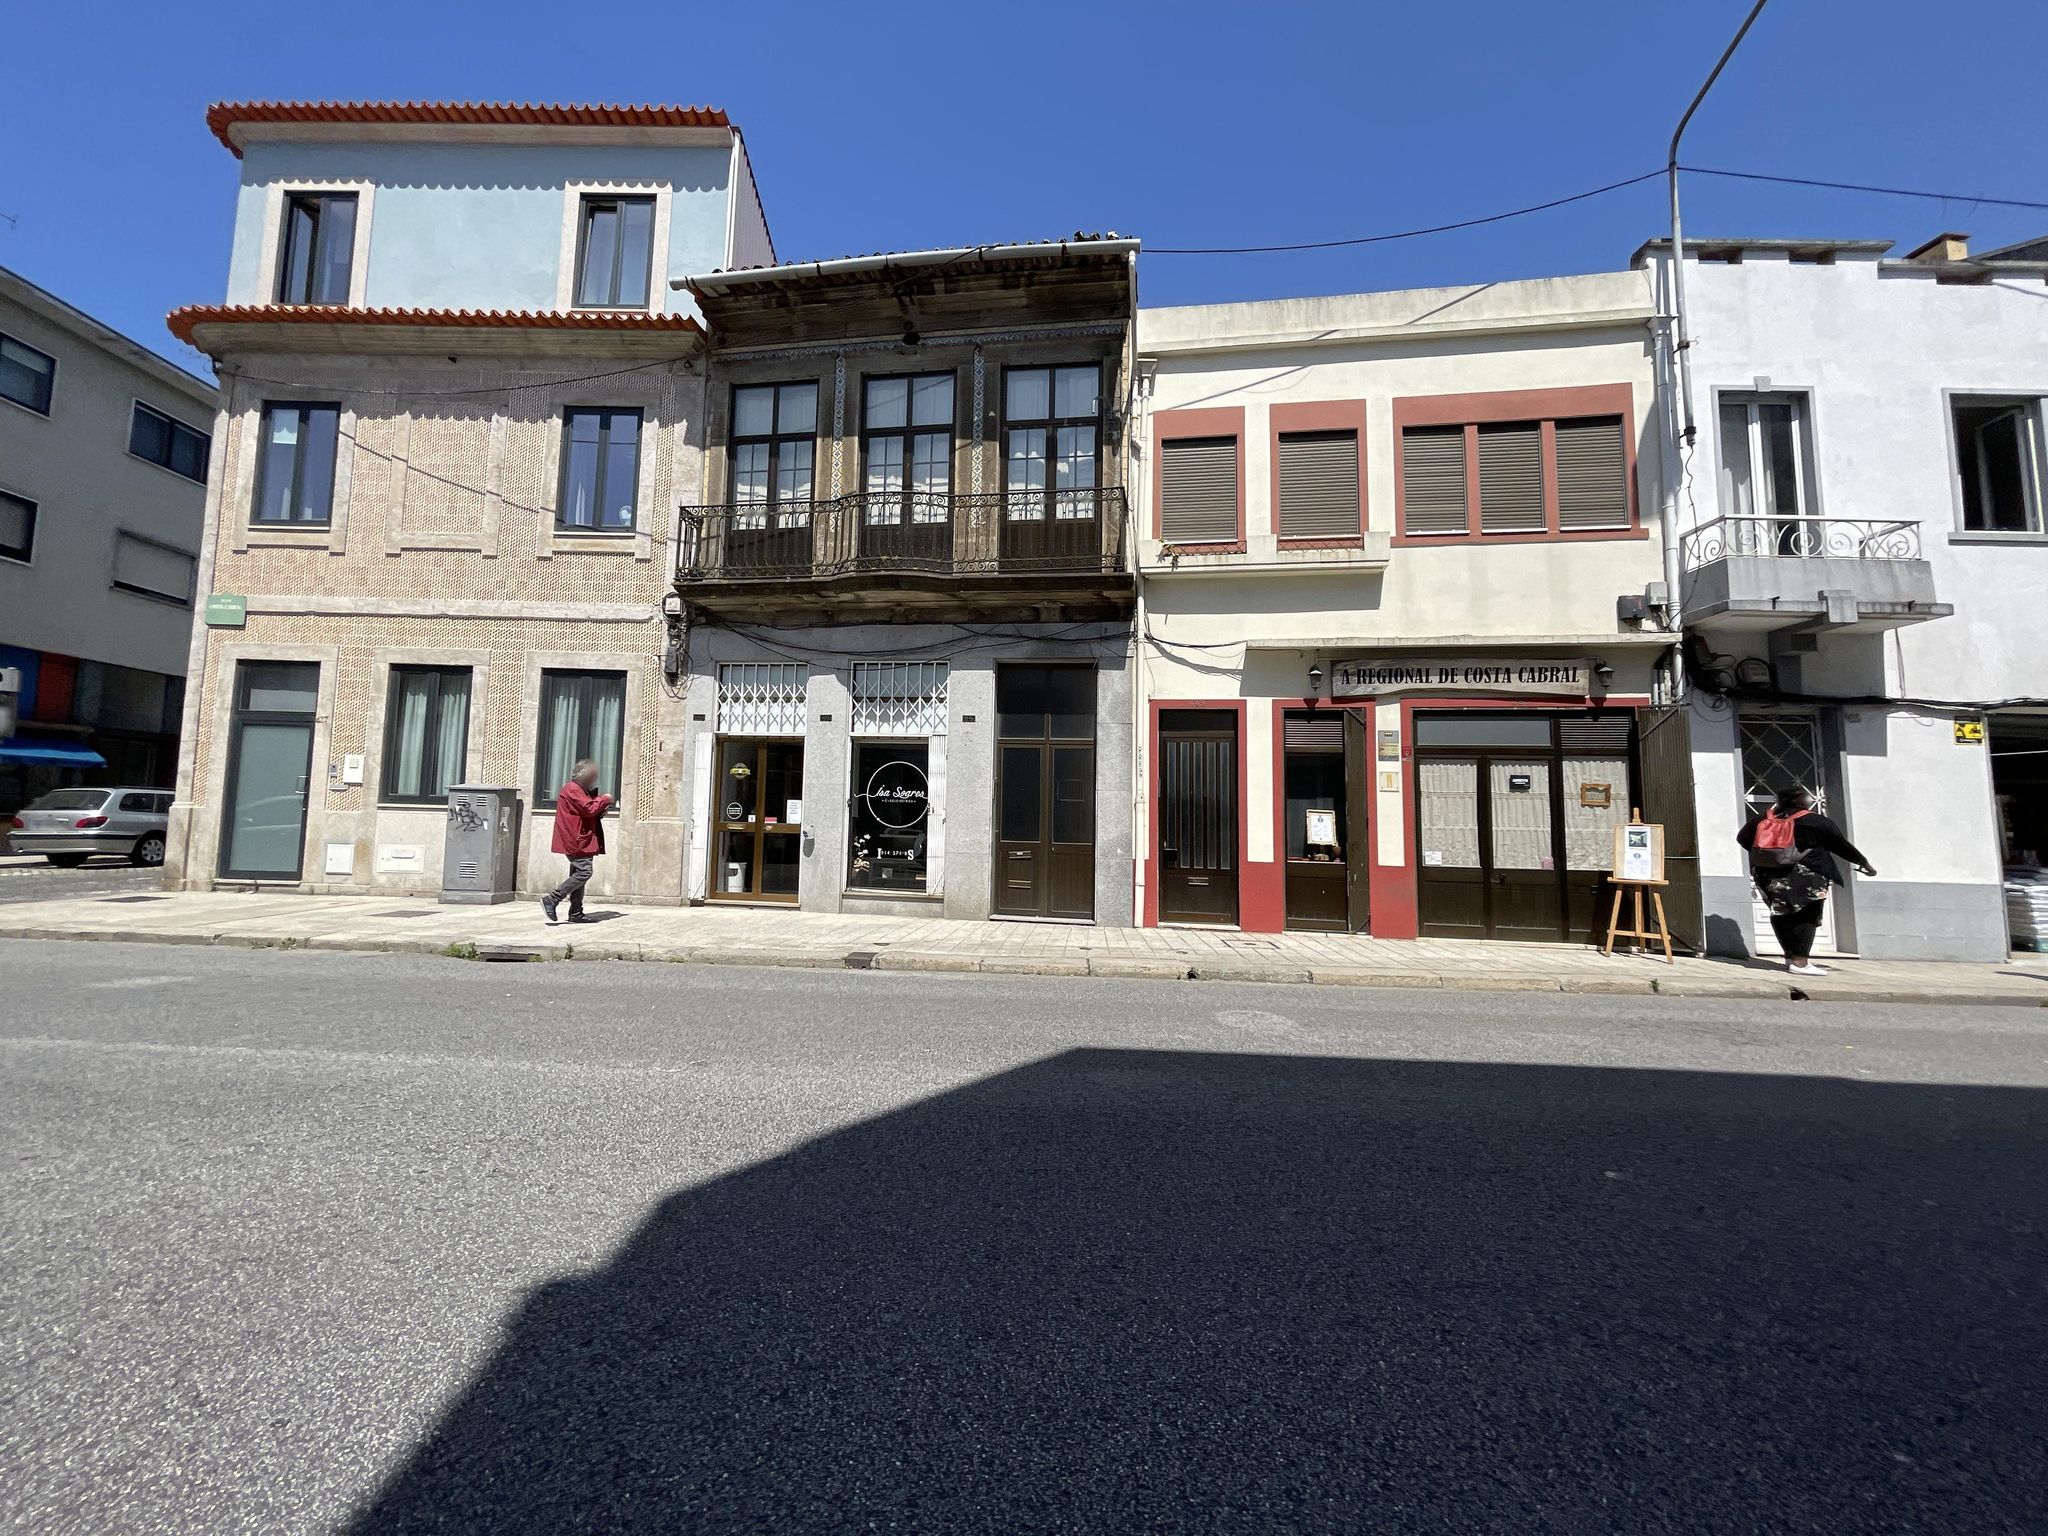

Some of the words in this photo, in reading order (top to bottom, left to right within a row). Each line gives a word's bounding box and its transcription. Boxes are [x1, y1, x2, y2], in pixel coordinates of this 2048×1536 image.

[1341, 669, 1350, 685] A
[1356, 667, 1432, 685] REGIONAL
[1438, 667, 1458, 684] DE
[1464, 666, 1512, 684] COSTA
[1518, 666, 1580, 684] CABRAL
[892, 786, 925, 800] Soares
